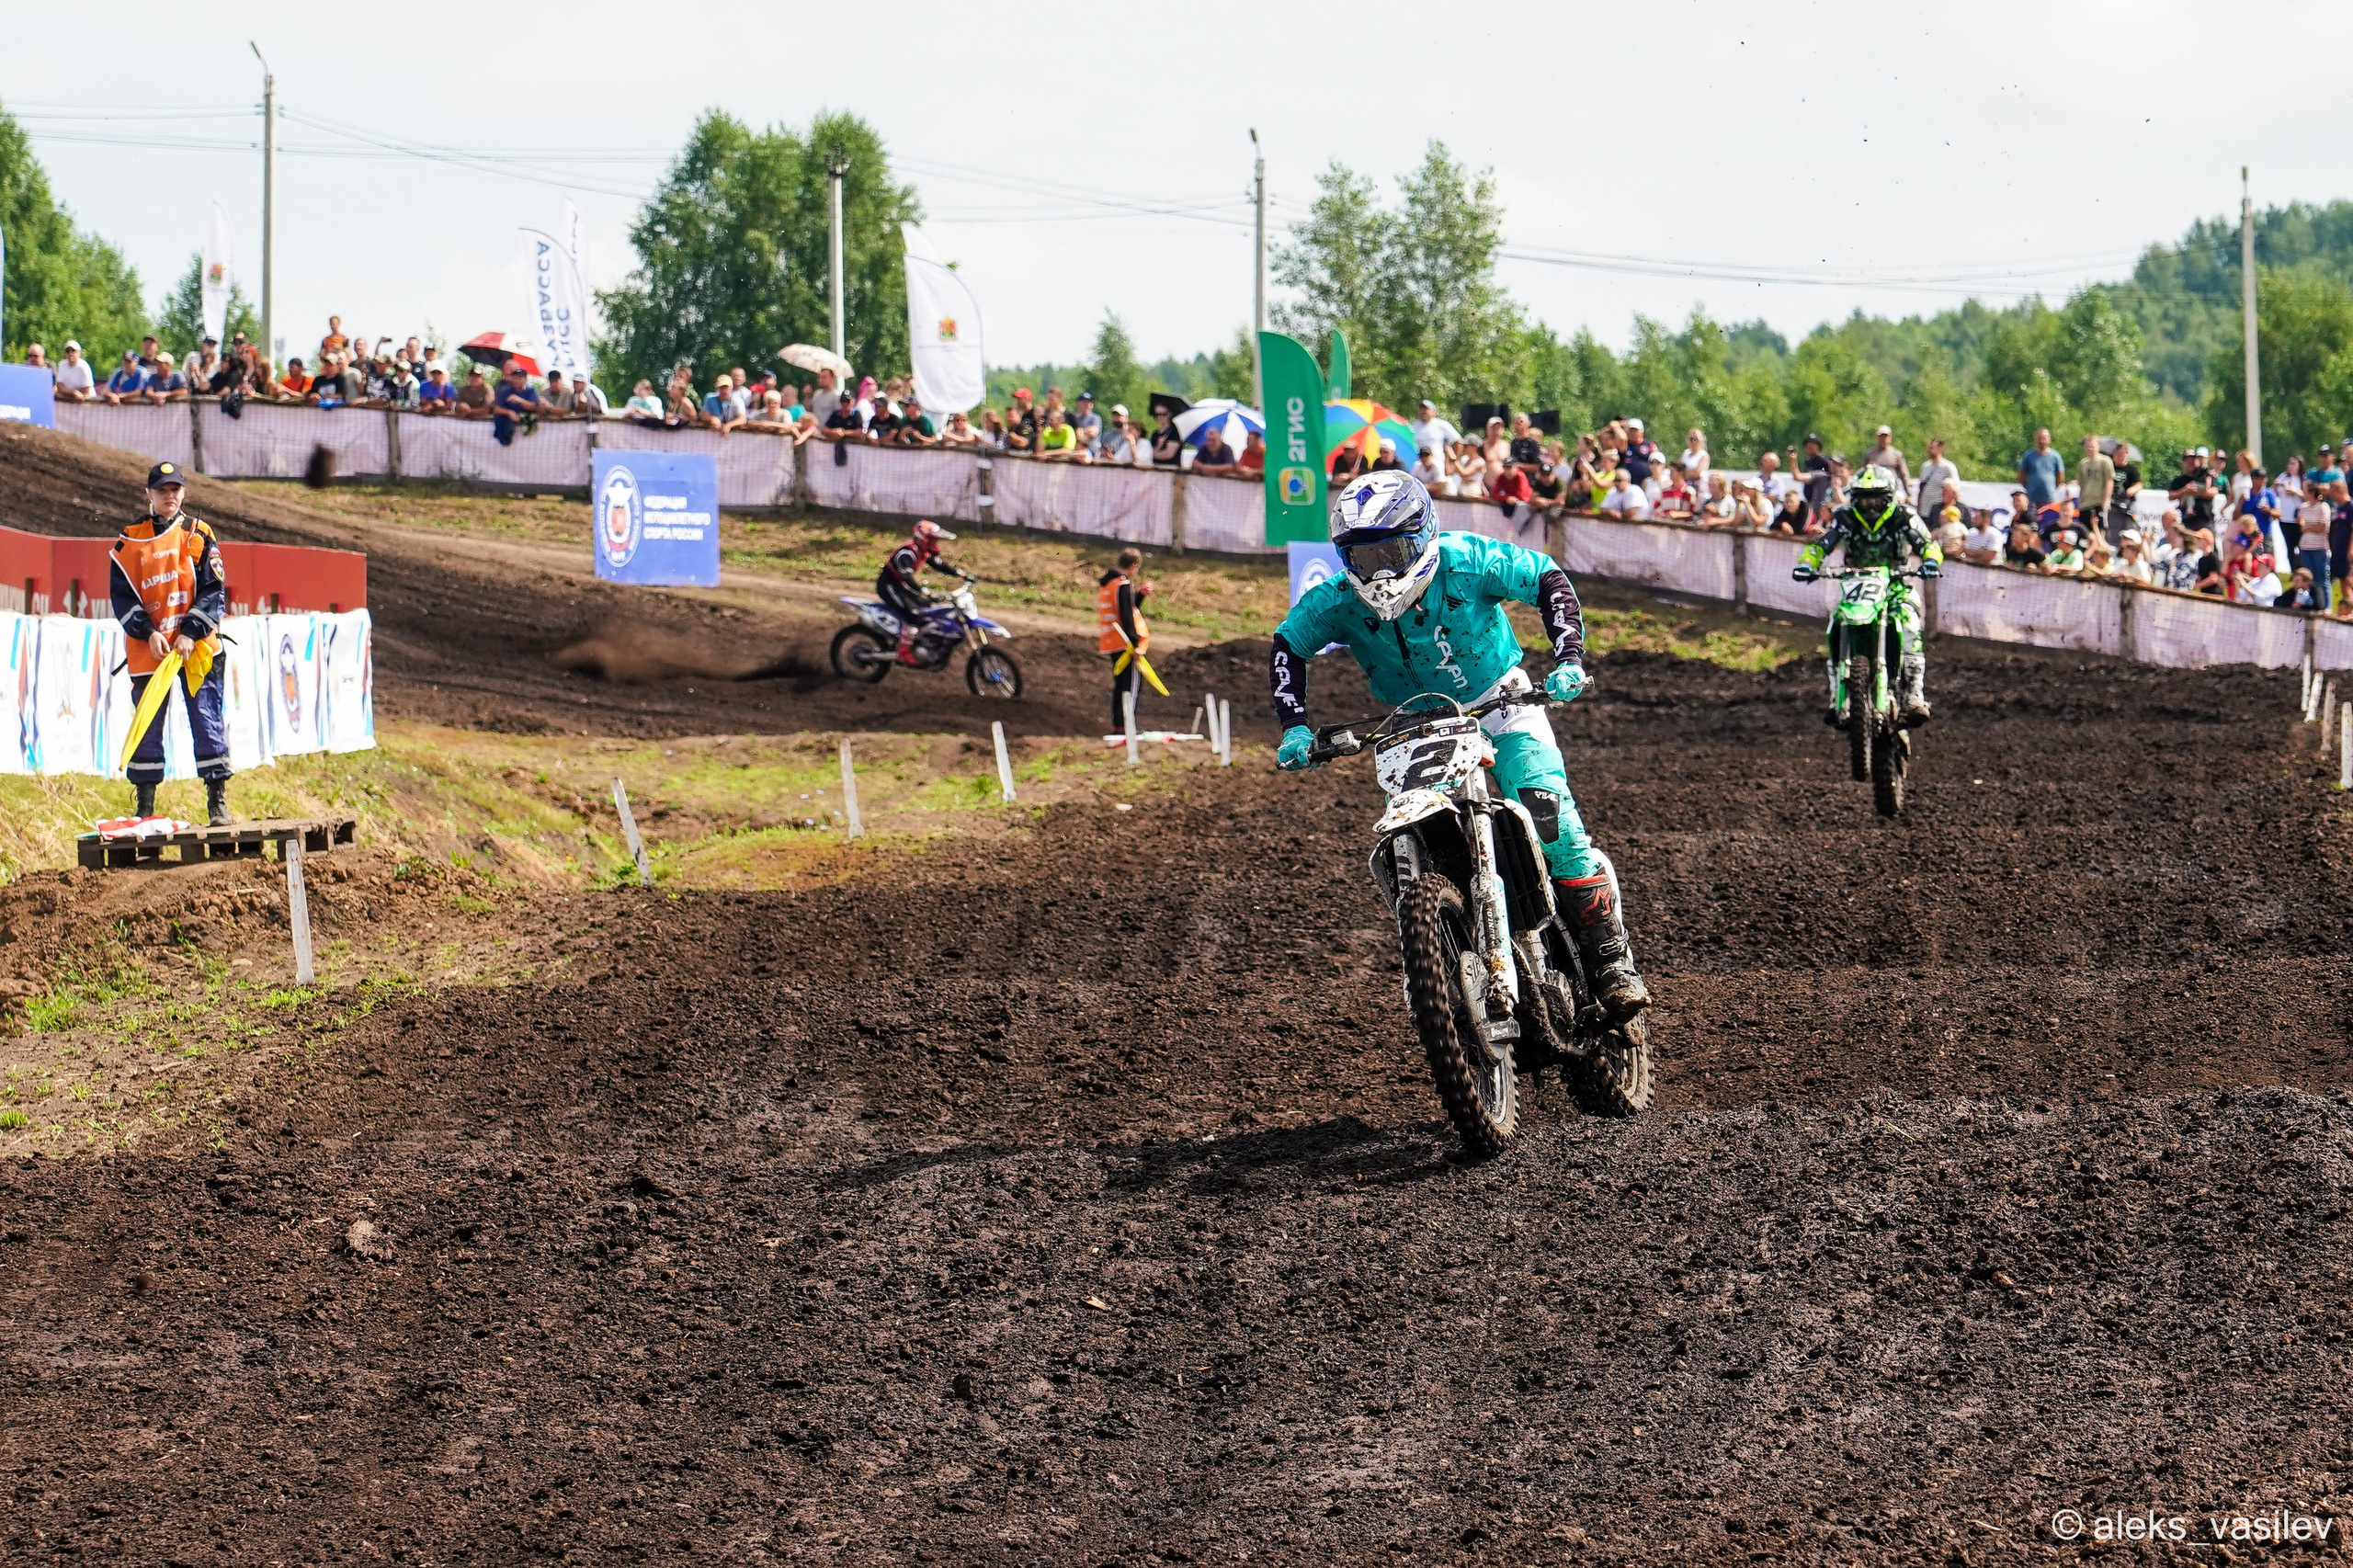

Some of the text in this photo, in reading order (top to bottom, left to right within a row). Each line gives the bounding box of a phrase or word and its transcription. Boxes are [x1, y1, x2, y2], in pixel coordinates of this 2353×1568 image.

[1288, 395, 1306, 463] 2ГИС
[1846, 583, 1881, 602] 42
[1401, 738, 1459, 792] 2
